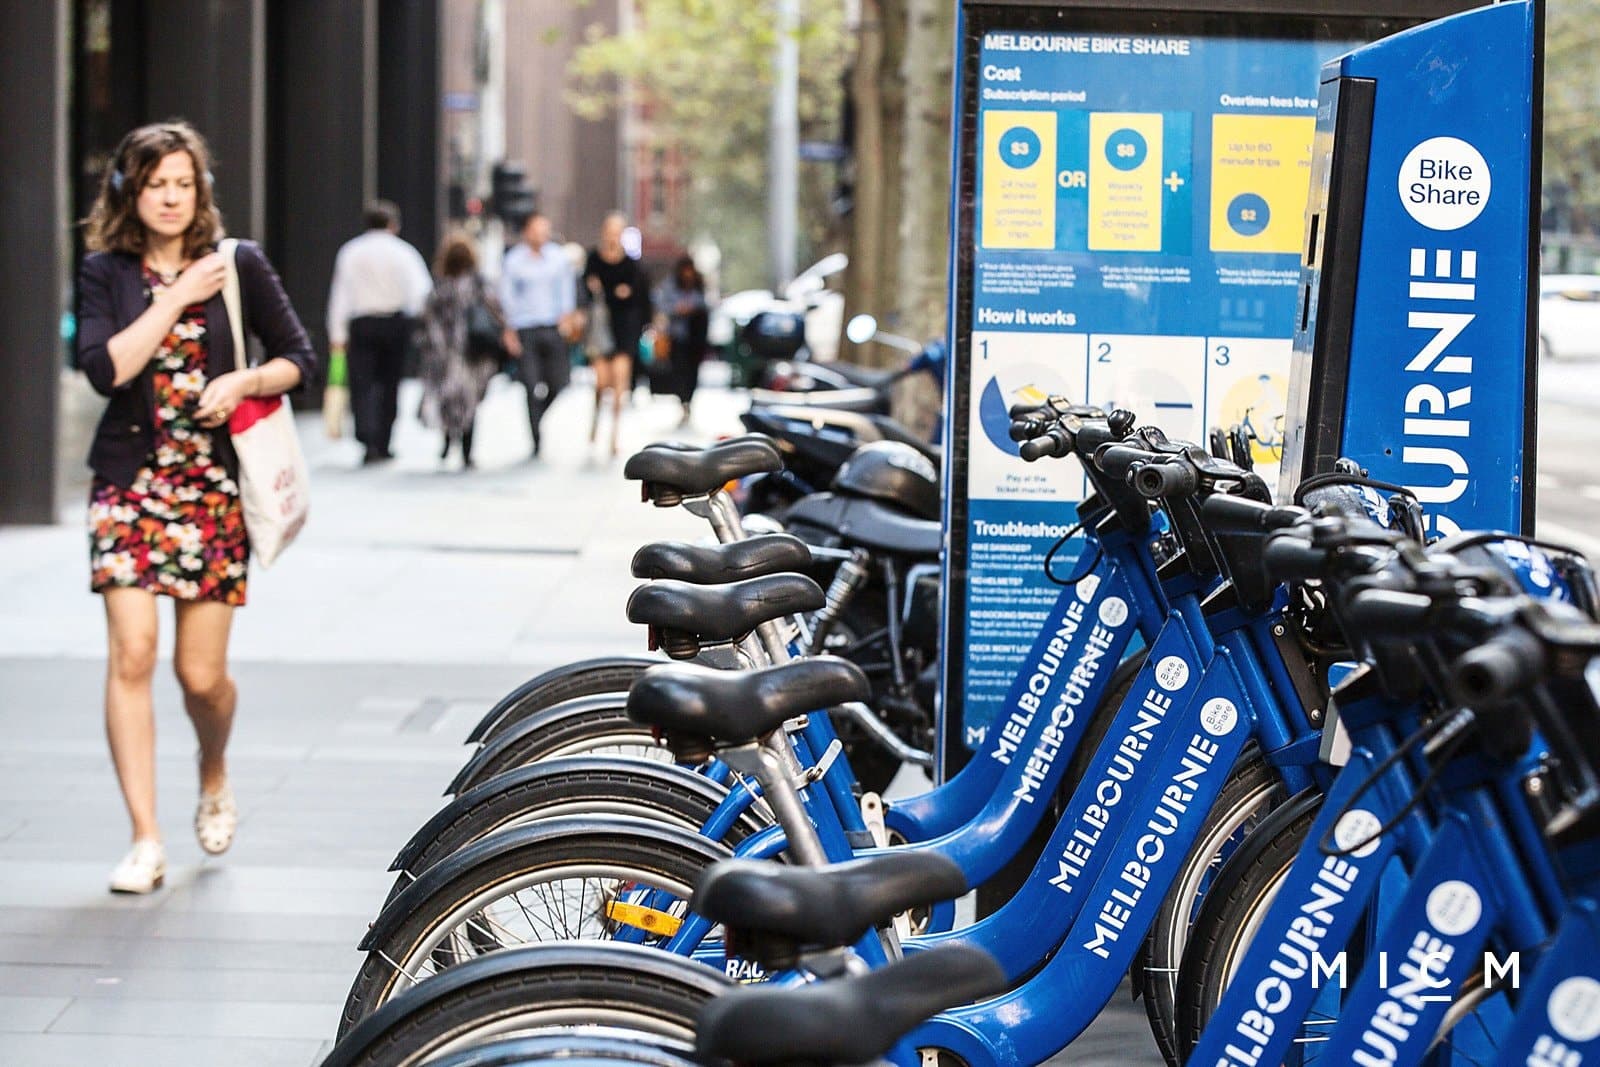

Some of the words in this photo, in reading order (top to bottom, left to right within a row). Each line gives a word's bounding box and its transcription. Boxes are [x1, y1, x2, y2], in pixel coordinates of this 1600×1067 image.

[984, 34, 1090, 53] MELBOURNE
[1091, 38, 1131, 54] BIKE
[1132, 39, 1191, 55] SHARE
[983, 65, 1022, 81] Cost
[983, 88, 1050, 101] Subscription
[1051, 91, 1086, 103] period
[1220, 93, 1269, 107] Overtime
[1270, 95, 1293, 108] fees
[1294, 97, 1310, 108] for
[1058, 170, 1086, 188] OR
[1419, 158, 1473, 181] Bike
[1409, 183, 1480, 206] Share
[978, 307, 1014, 325] How
[1015, 308, 1027, 325] it
[1028, 309, 1077, 326] works
[979, 339, 988, 361] 1
[1097, 342, 1112, 363] 2
[1215, 345, 1230, 367] 3
[991, 600, 1084, 765] MELBOURNE
[1013, 624, 1114, 804] MELBOURNE
[1205, 703, 1222, 725] Bike
[1213, 705, 1233, 732] Share
[1048, 688, 1172, 893] MELBOURNE
[1083, 733, 1219, 959] MELBOURNE
